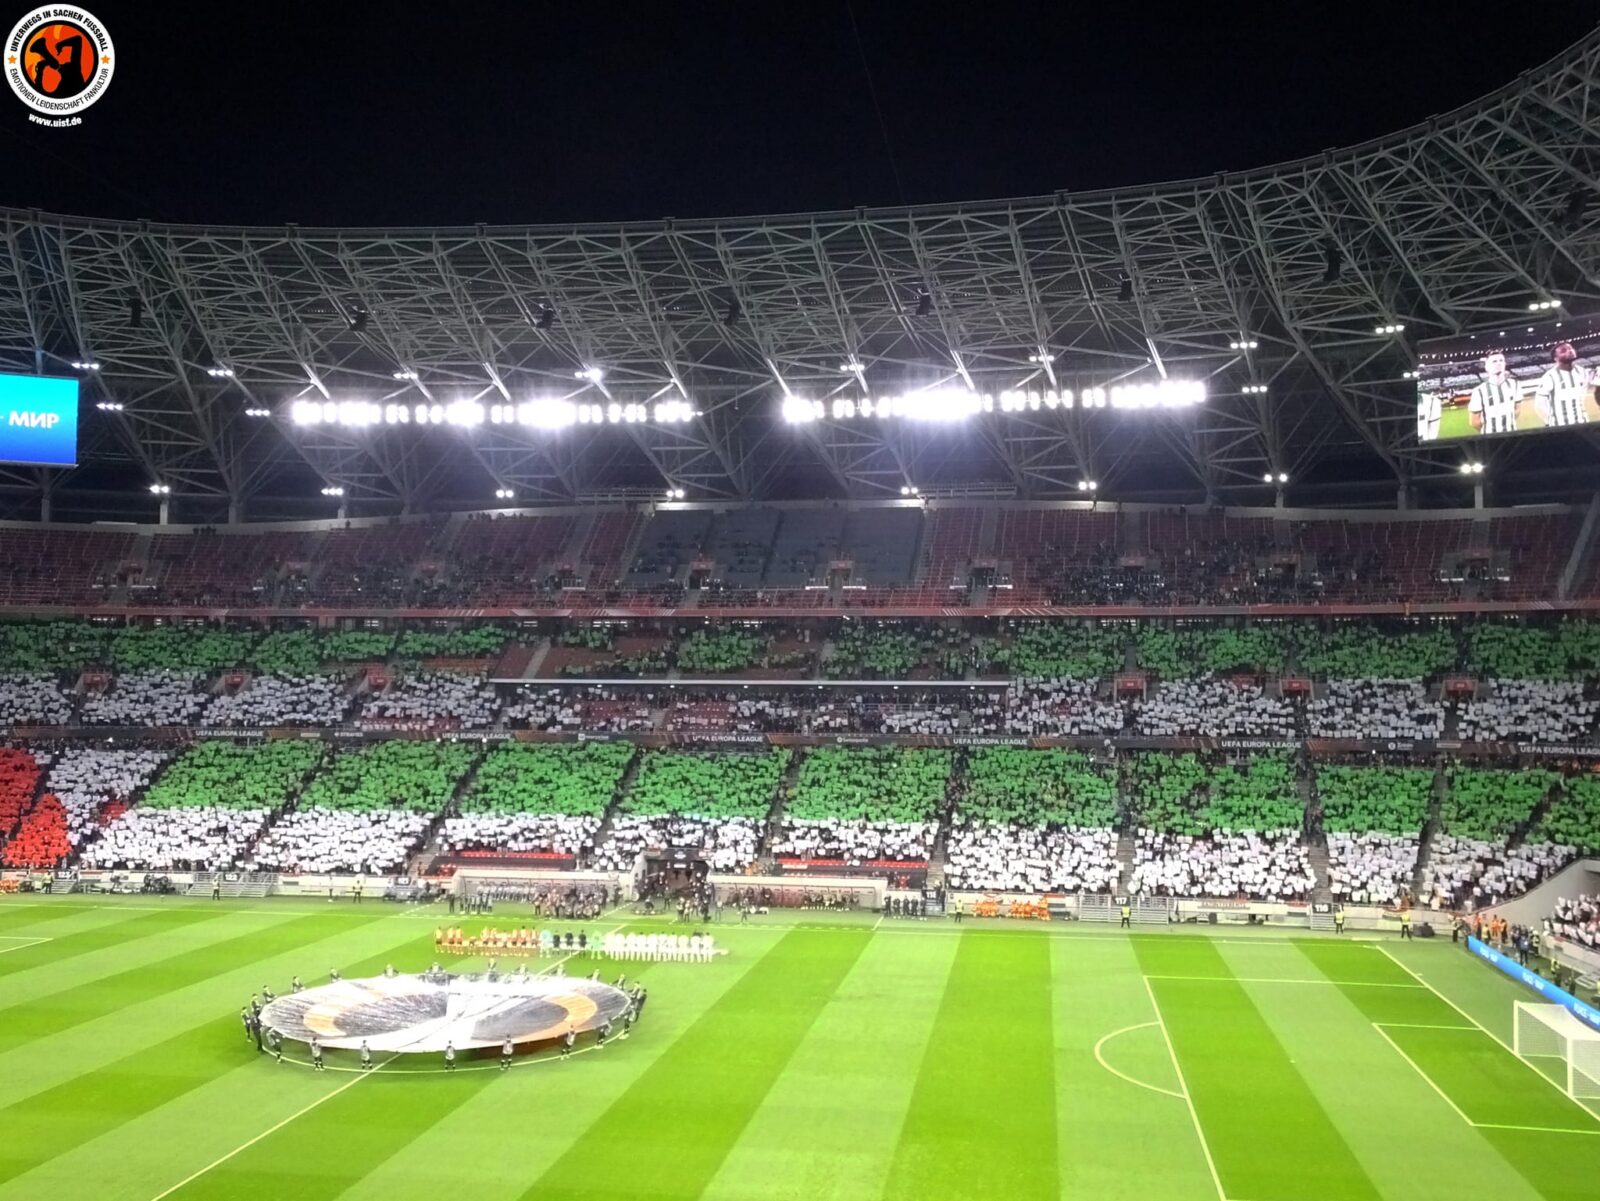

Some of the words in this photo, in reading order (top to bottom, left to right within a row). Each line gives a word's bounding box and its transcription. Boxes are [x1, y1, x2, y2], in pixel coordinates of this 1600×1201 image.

[8, 410, 60, 429] МИР
[1543, 746, 1575, 754] EUROPA
[1115, 897, 1127, 905] 117
